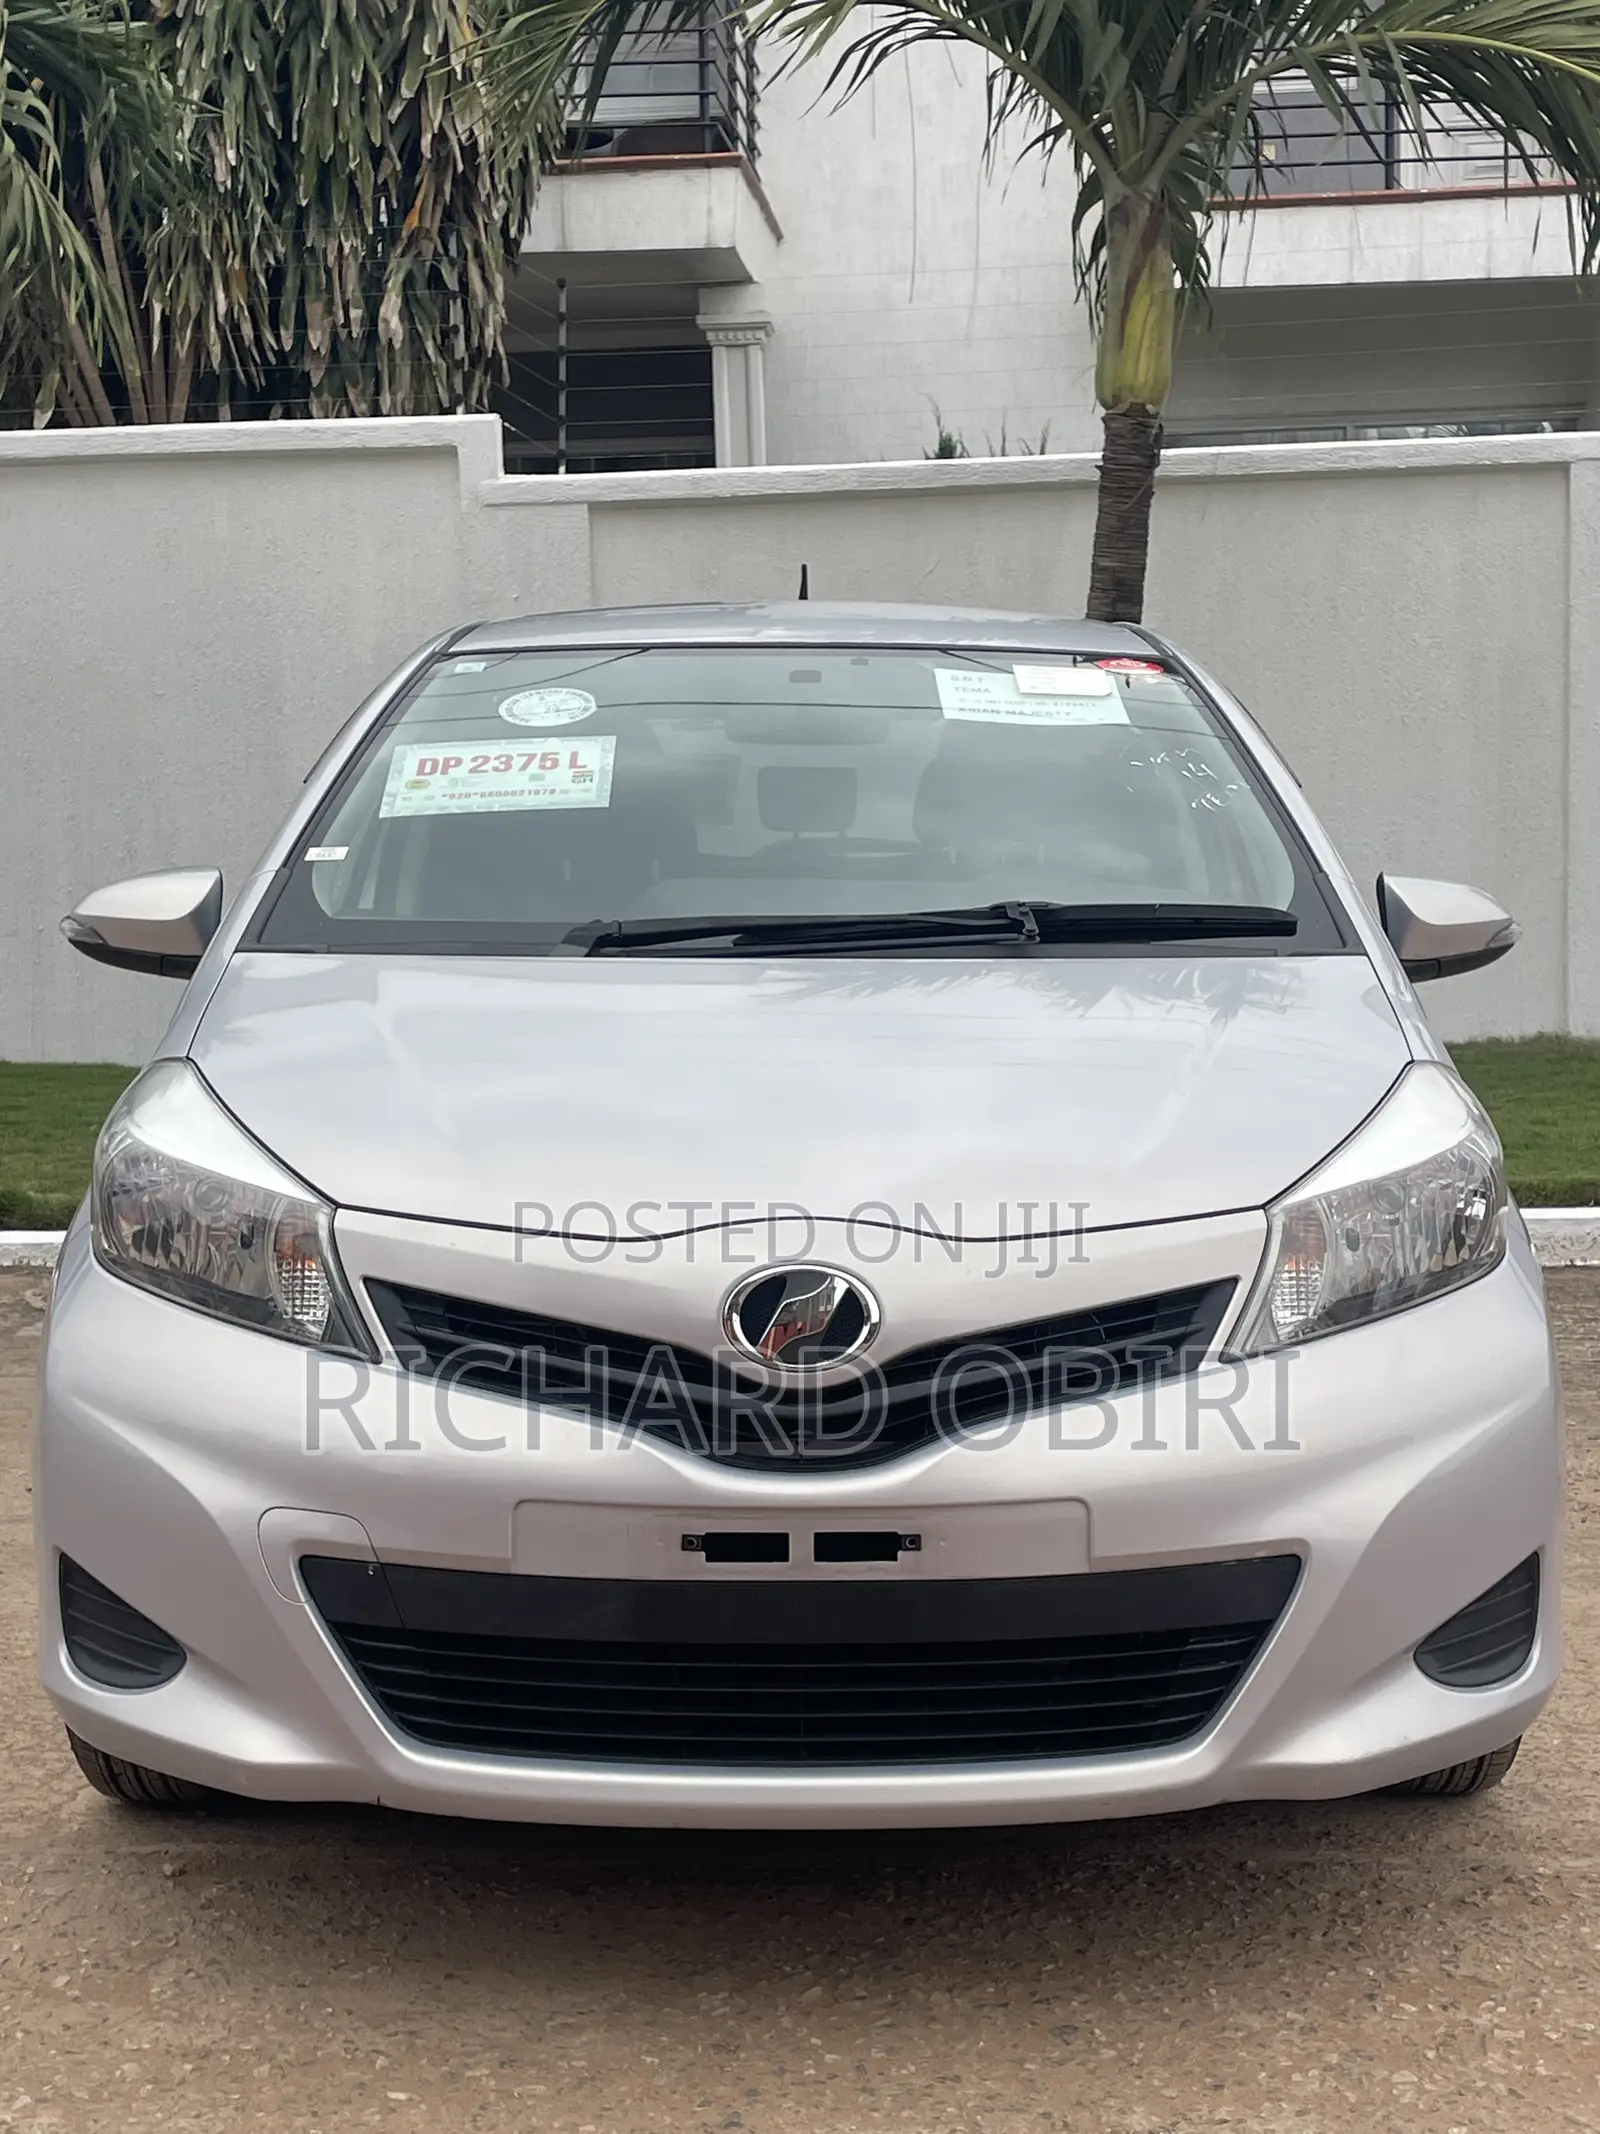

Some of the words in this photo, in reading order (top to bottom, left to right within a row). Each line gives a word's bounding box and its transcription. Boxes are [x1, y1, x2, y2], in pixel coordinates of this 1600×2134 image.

[416, 757, 463, 776] DP
[468, 752, 560, 774] 2375
[568, 751, 588, 769] L
